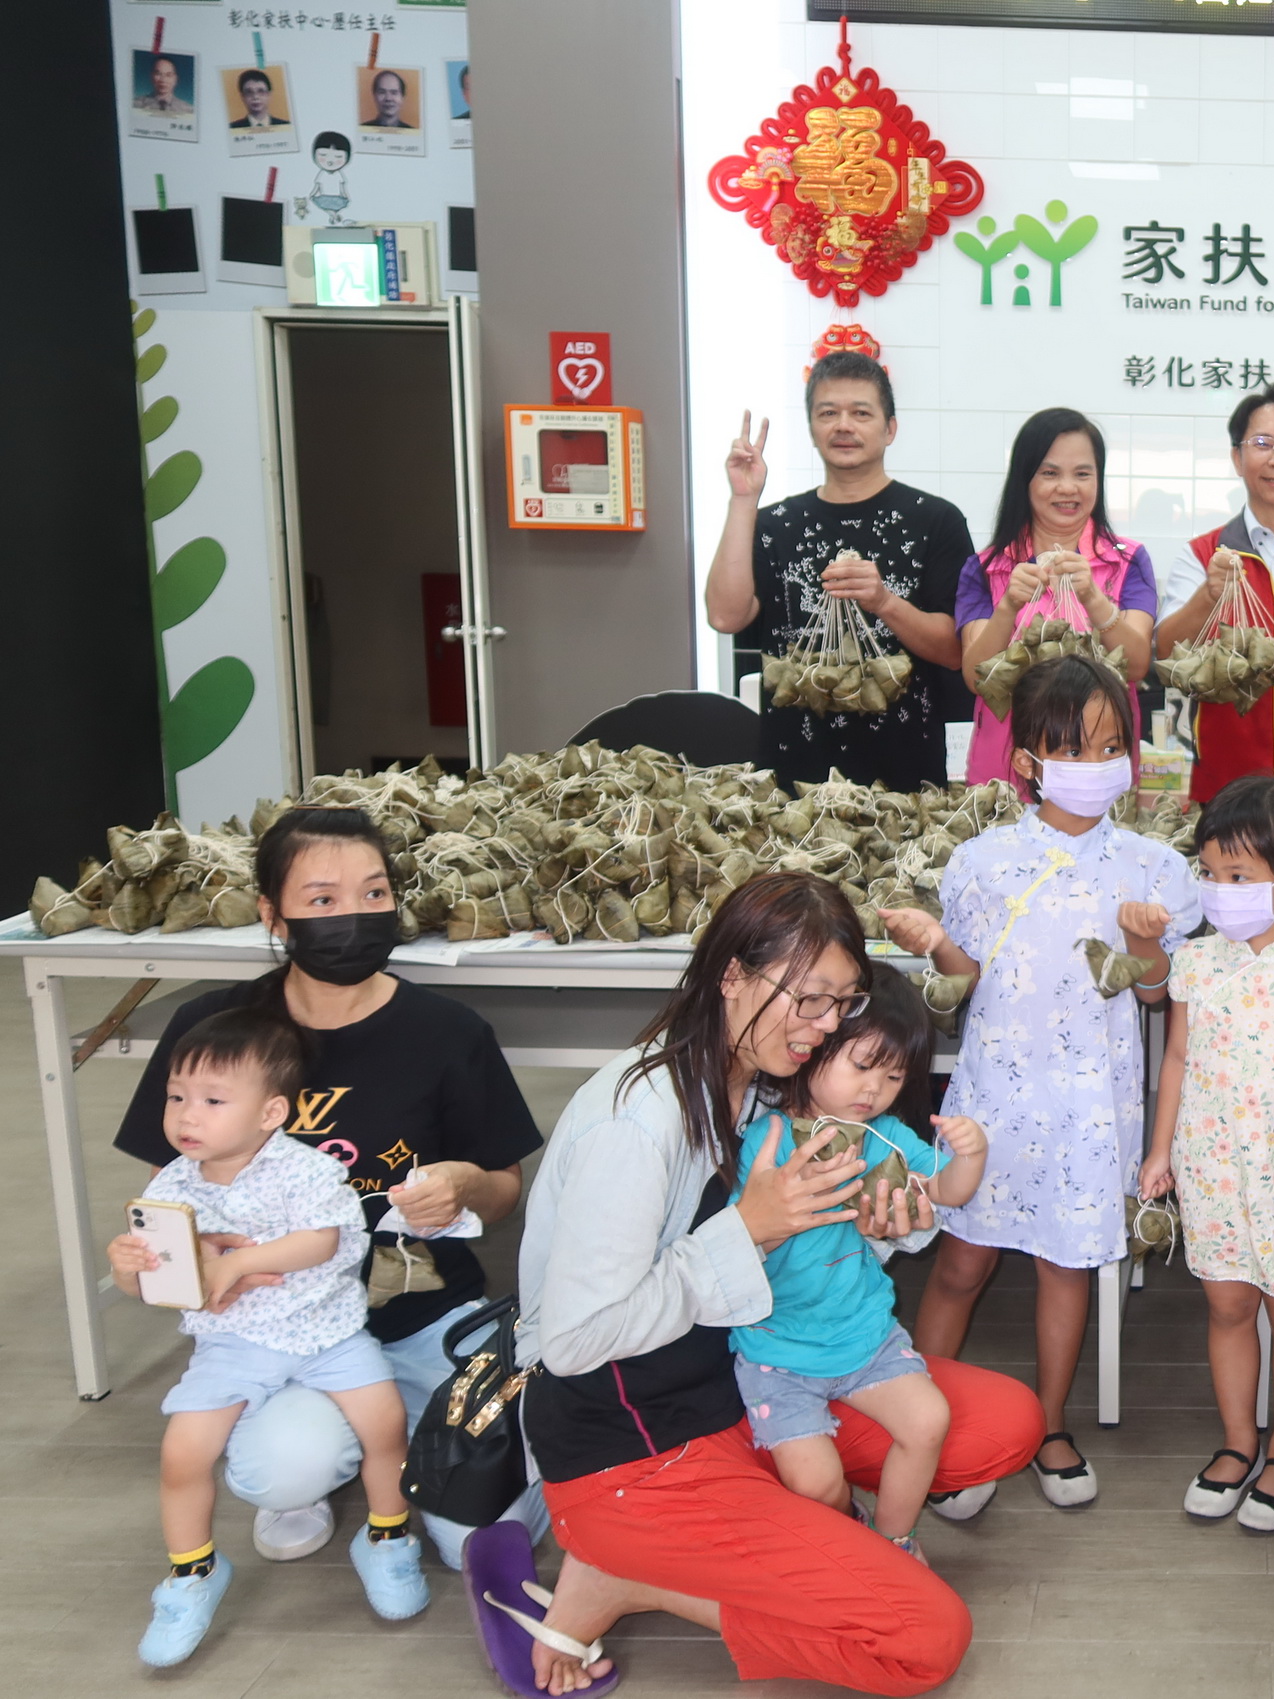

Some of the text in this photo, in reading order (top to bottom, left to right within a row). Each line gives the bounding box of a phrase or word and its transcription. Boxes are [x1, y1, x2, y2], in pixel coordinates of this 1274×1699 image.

[791, 106, 900, 217] 福
[1122, 293, 1191, 311] Taiwan
[1200, 295, 1247, 312] Fund
[564, 341, 597, 355] AED
